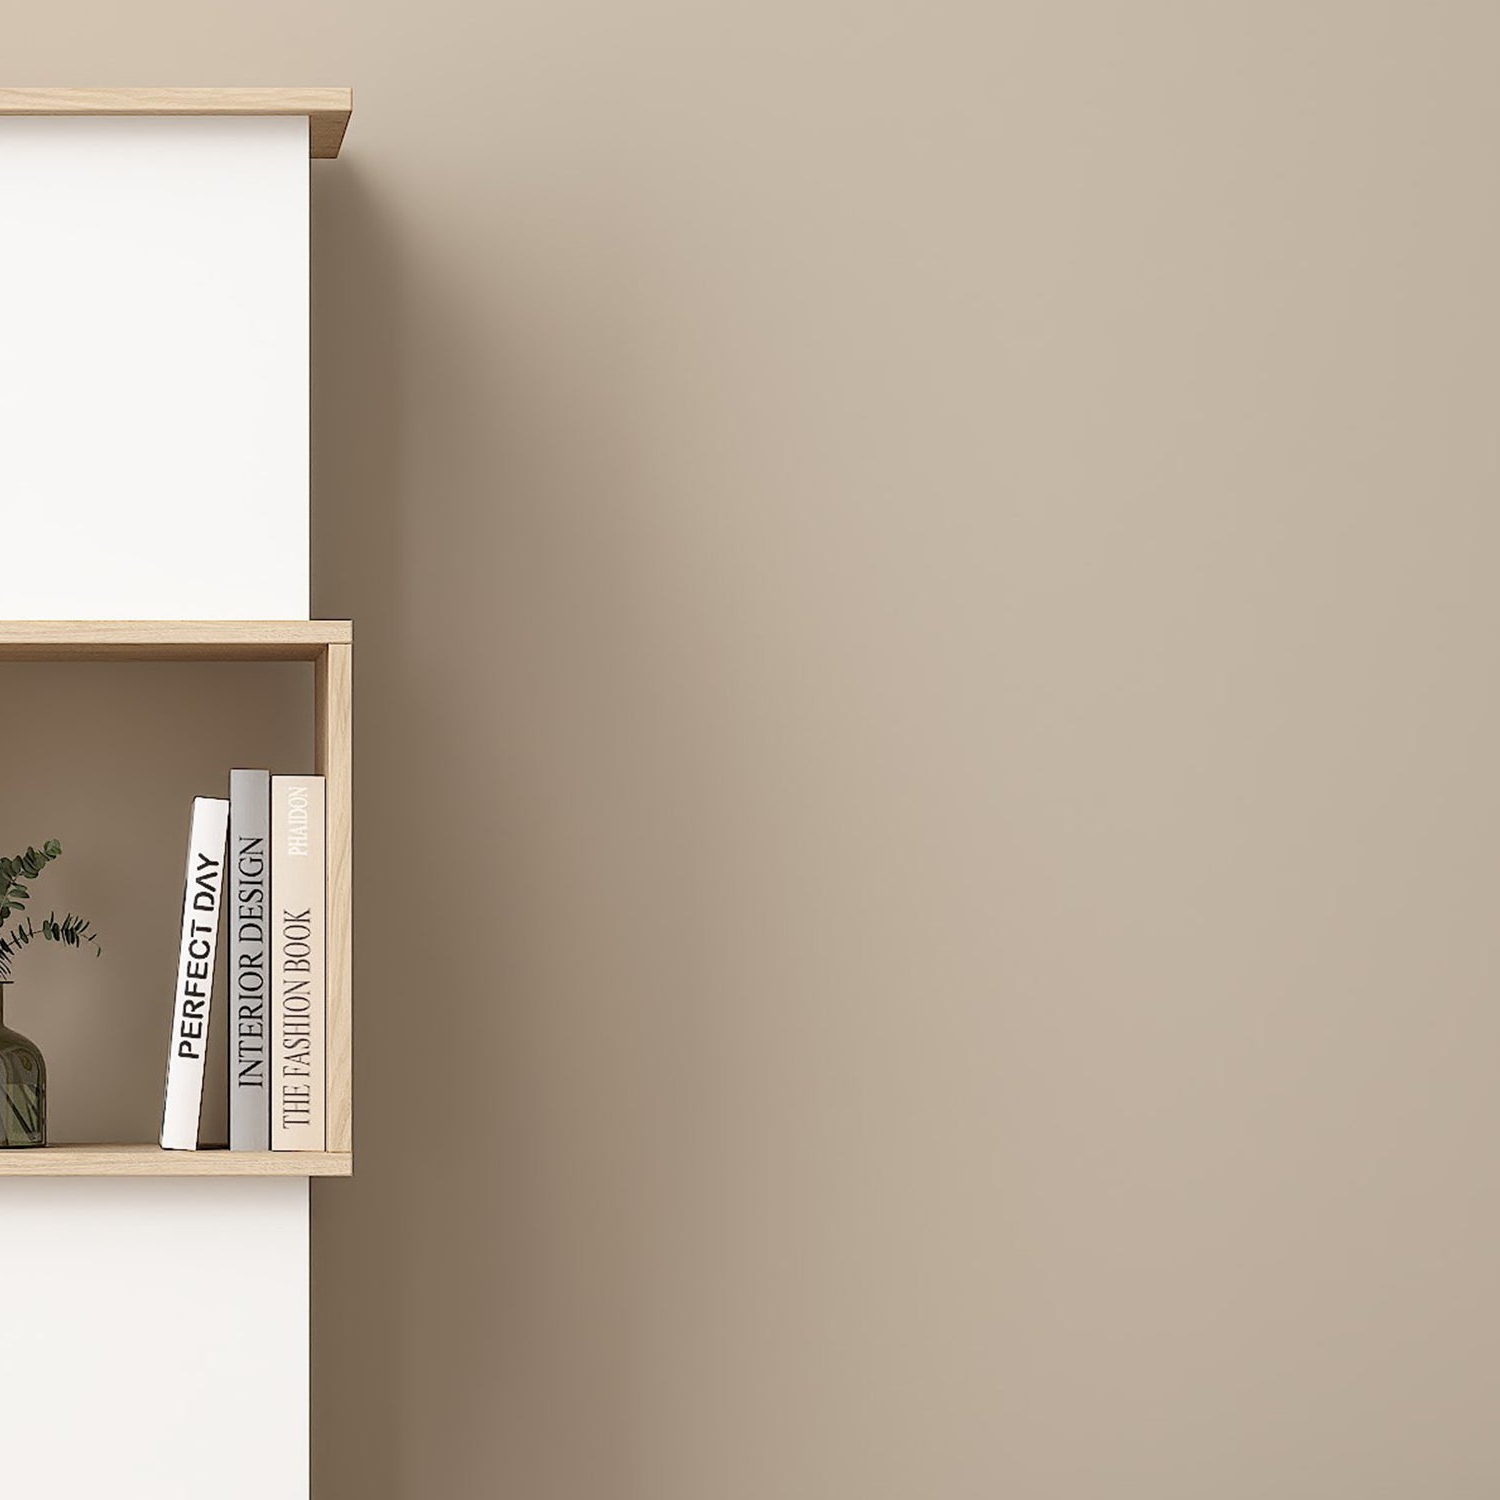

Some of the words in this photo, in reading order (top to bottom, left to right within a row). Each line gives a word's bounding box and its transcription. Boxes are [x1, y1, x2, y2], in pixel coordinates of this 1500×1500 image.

[288, 786, 308, 856] PHAIDON
[194, 852, 220, 911] DAY
[238, 836, 264, 944] DESIGN
[283, 908, 311, 972] BOOK
[178, 920, 211, 1059] PERFECT
[238, 951, 264, 1088] INTERIOR
[283, 980, 311, 1077] FASHION
[283, 1083, 311, 1130] THE
